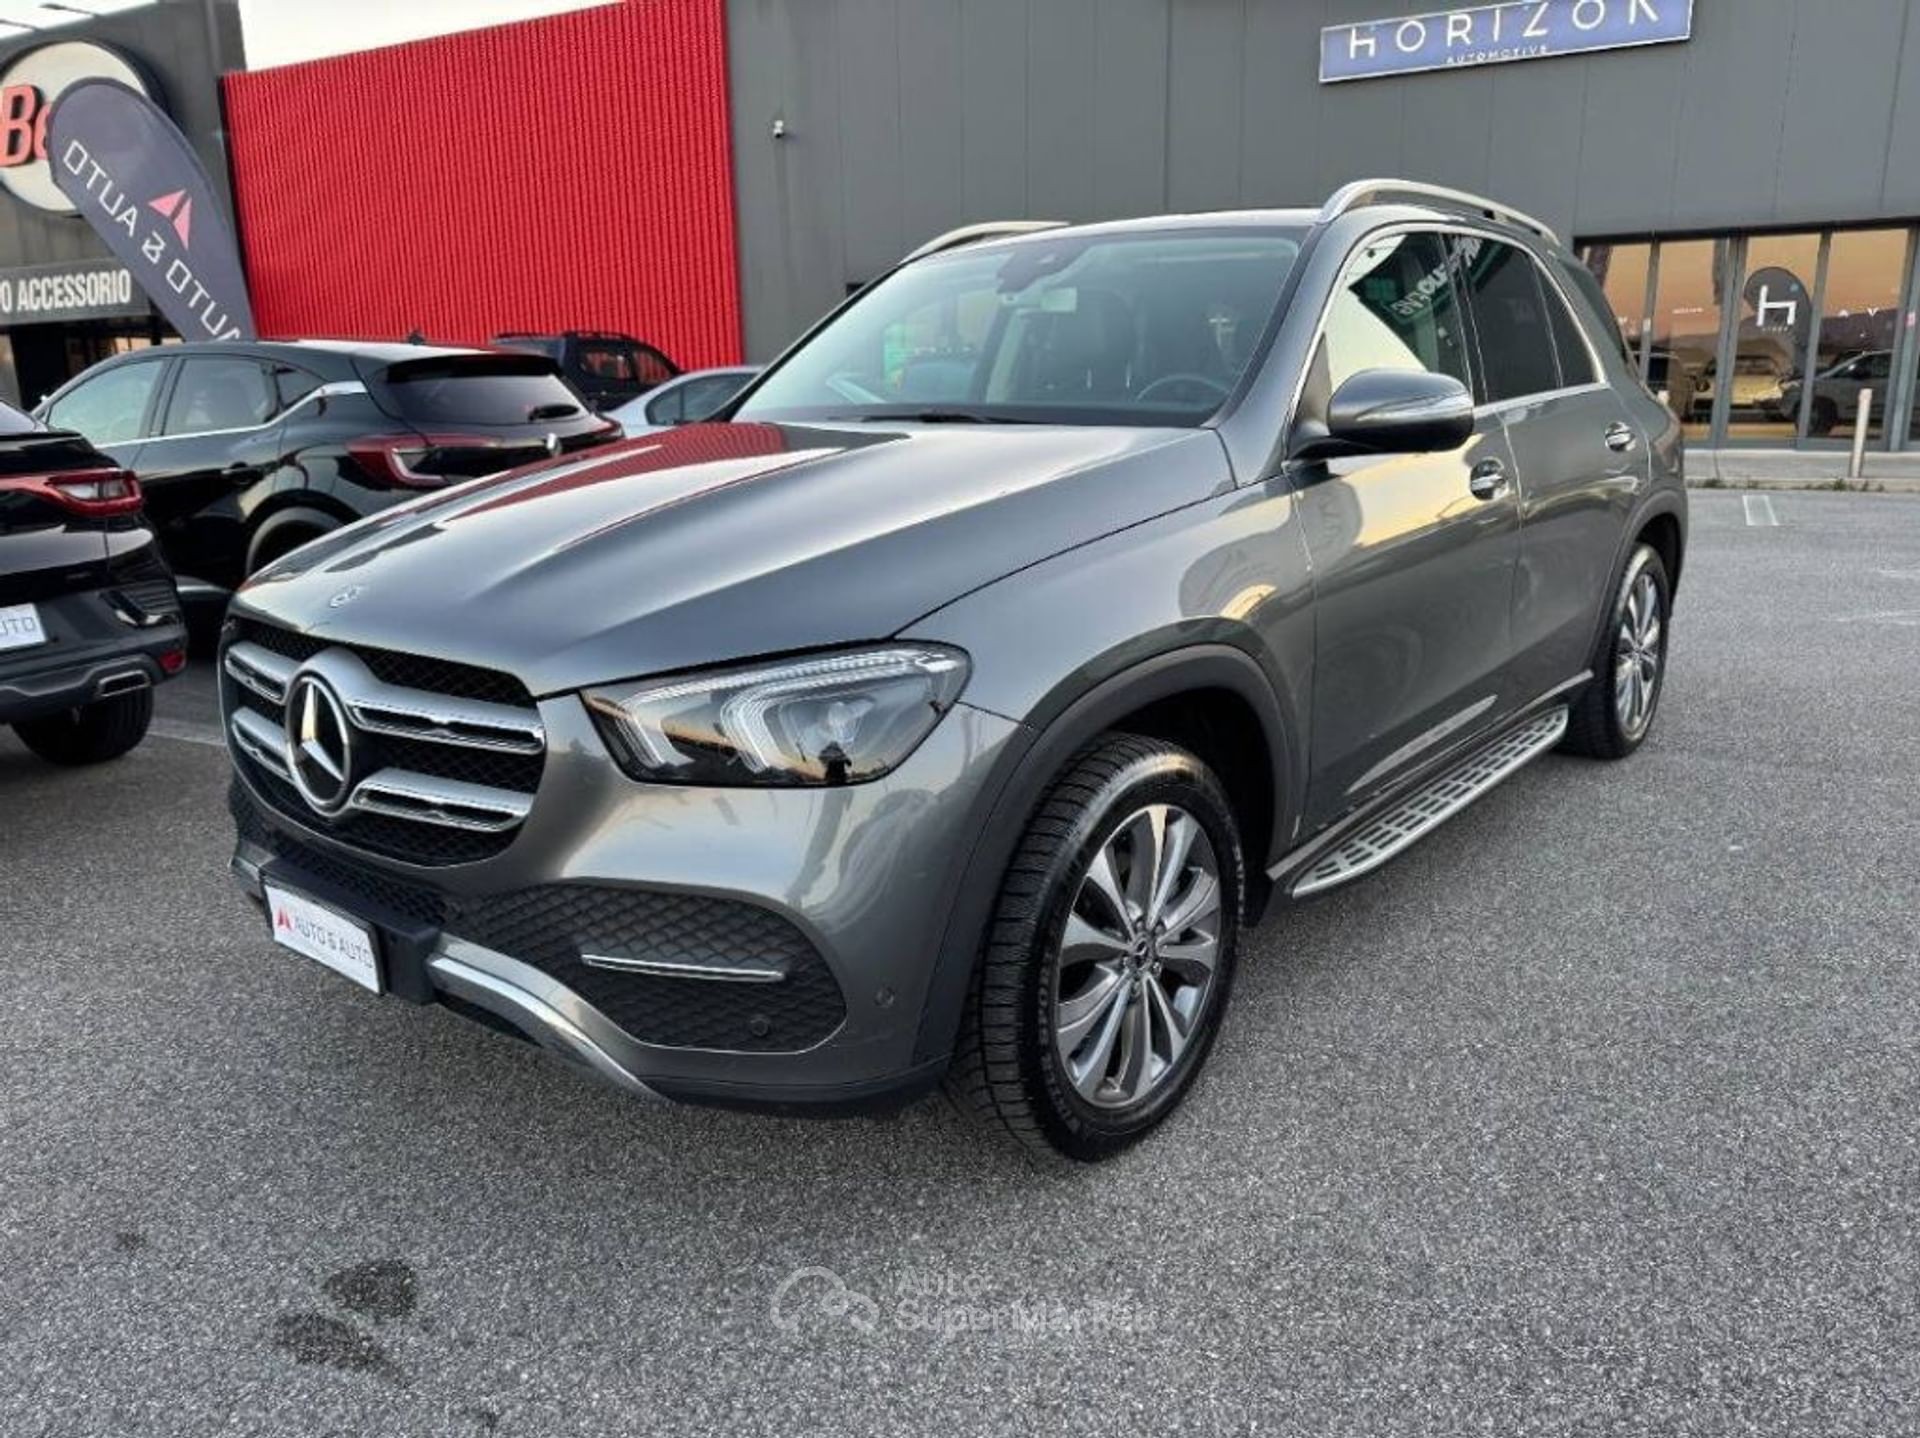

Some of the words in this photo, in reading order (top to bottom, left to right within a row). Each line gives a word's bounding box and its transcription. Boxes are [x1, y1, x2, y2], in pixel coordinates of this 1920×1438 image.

[1446, 45, 1547, 65] AUTOMOTIVE
[17, 268, 131, 312] ACCESSORIO
[294, 916, 327, 945] AUTO
[339, 938, 374, 969] AUTO
